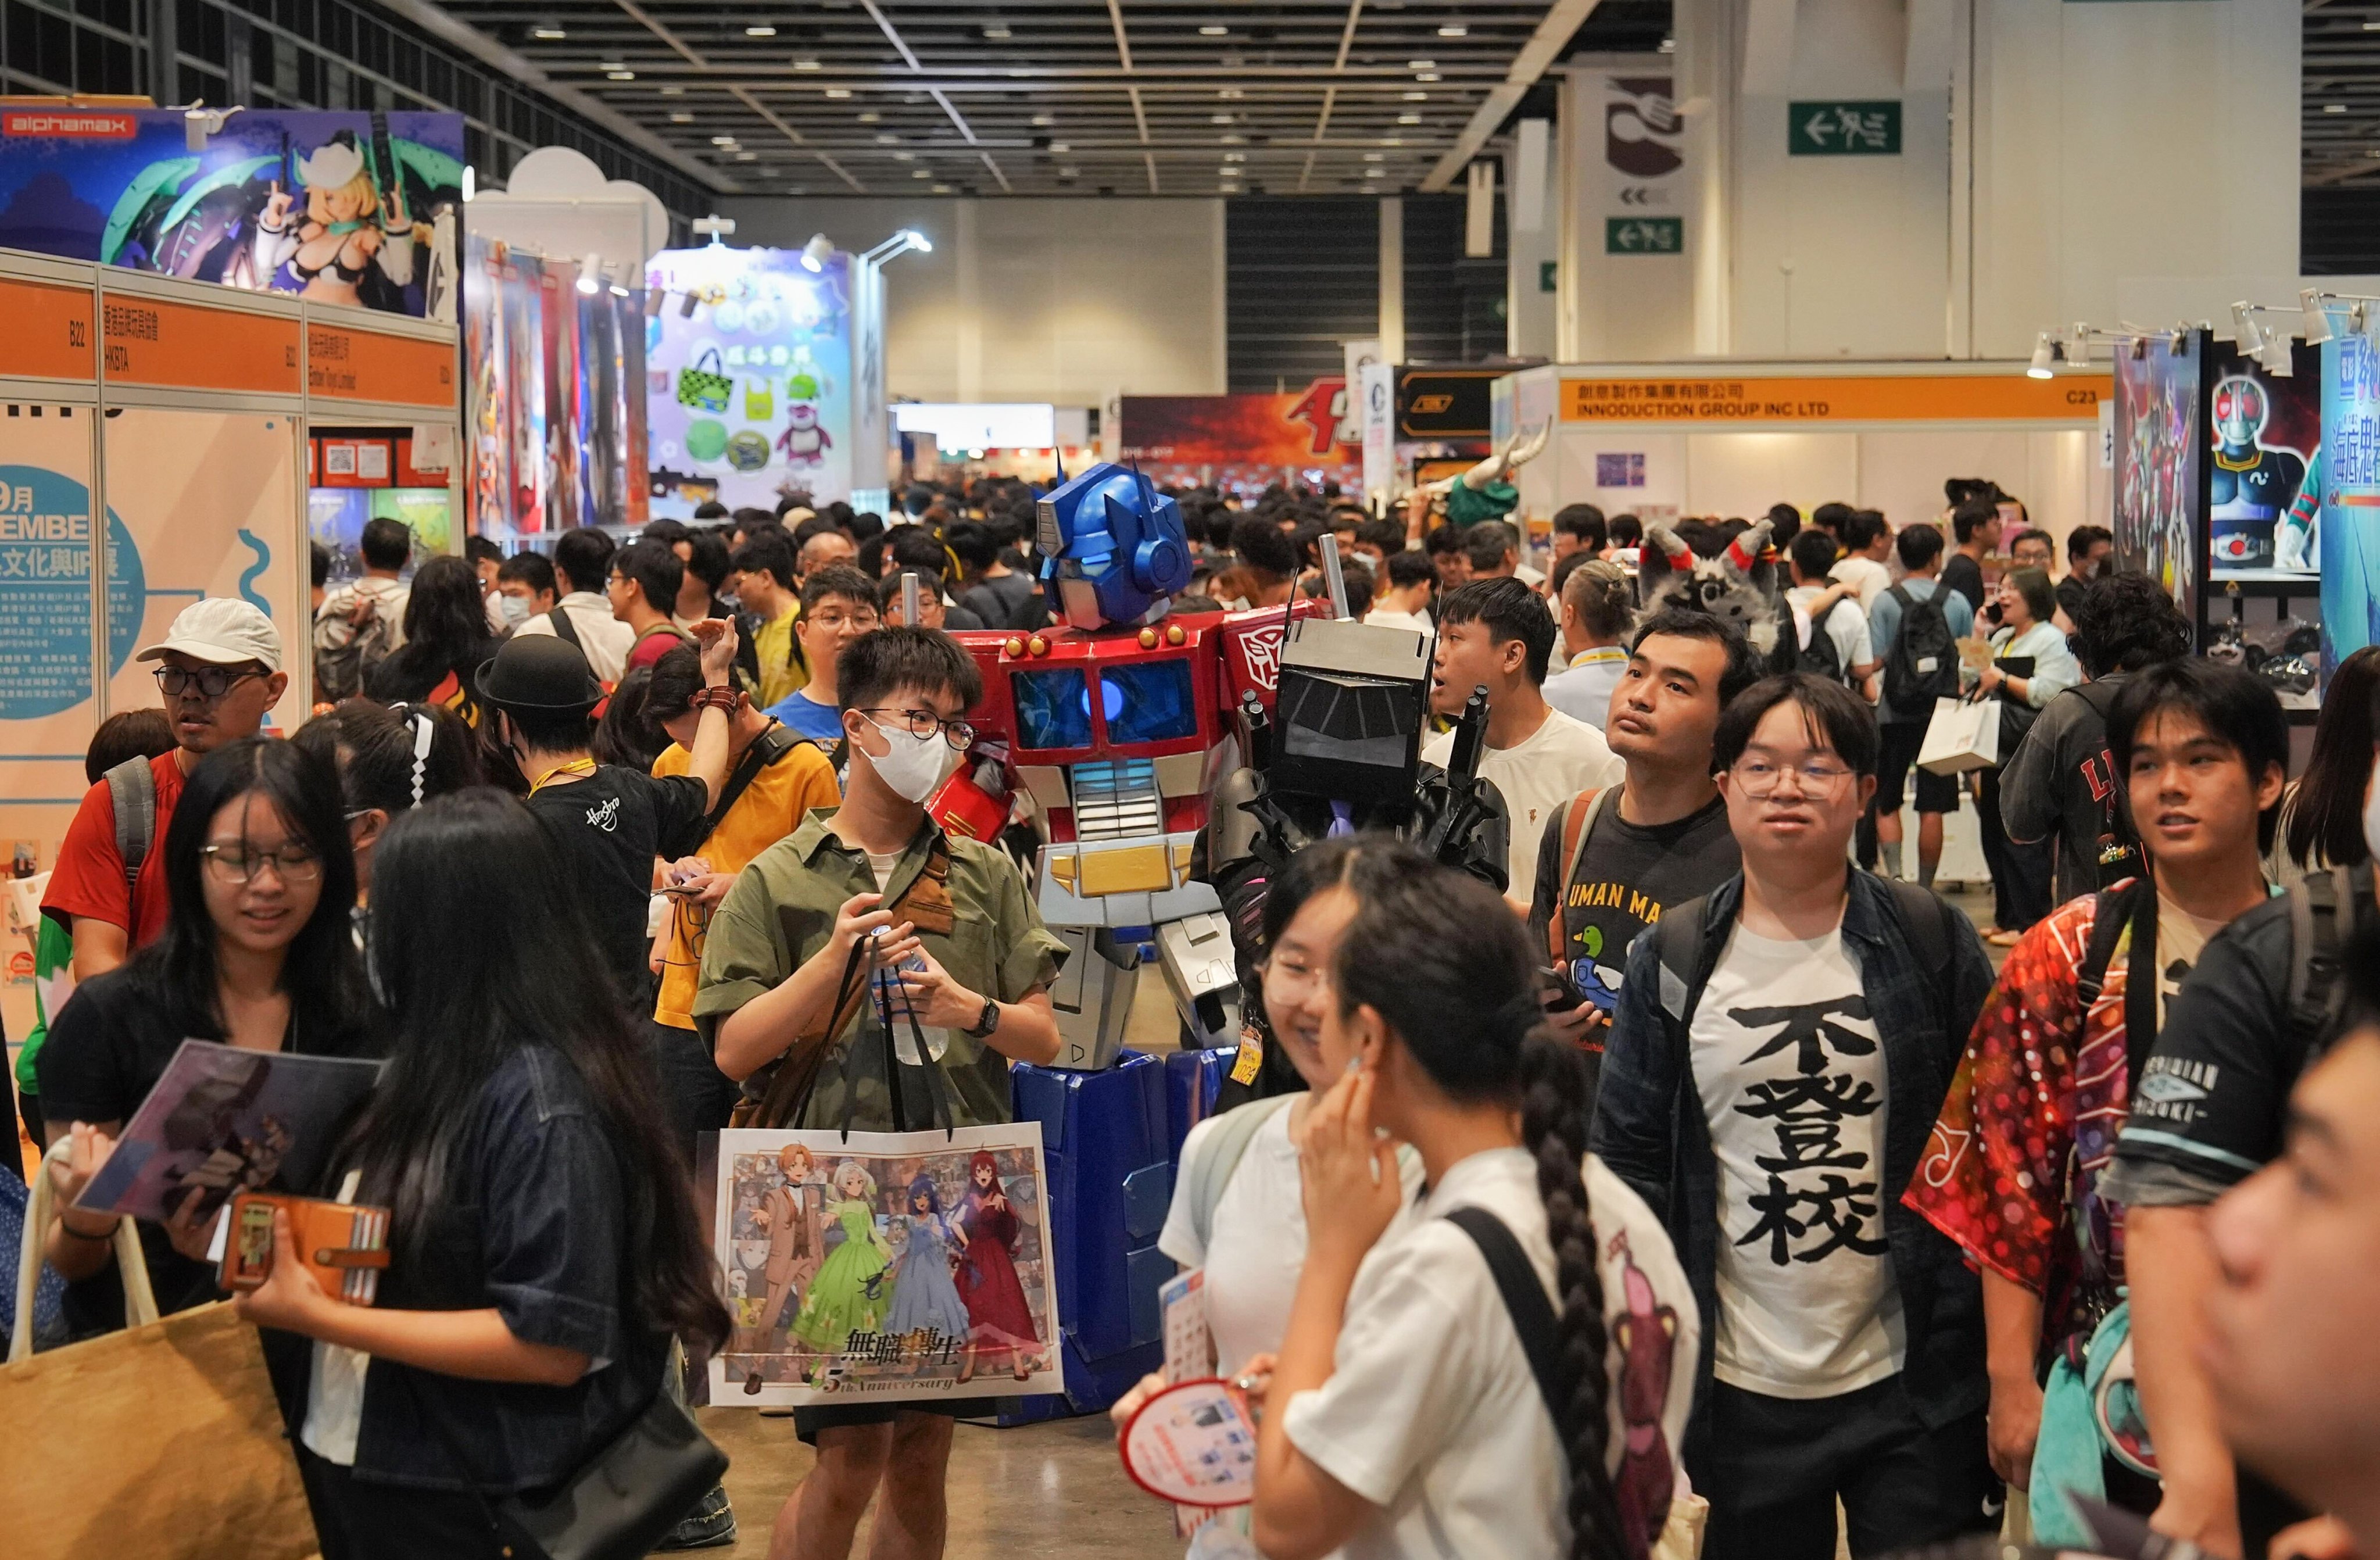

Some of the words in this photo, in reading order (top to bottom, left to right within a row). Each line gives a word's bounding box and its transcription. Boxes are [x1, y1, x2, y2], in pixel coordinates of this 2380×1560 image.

[12, 116, 126, 133] alphamax
[70, 320, 85, 348] B22
[105, 345, 130, 373] HKBTA
[1577, 402, 1694, 417] INNODUCTION
[1699, 402, 1759, 417] GROUP
[1765, 401, 1794, 415] INC
[1798, 401, 1830, 416] LTD
[2066, 389, 2097, 405] C23
[585, 797, 620, 826] Hasbro
[1569, 882, 1624, 908] UMAN
[1726, 994, 1889, 1266] 不登校
[857, 1378, 954, 1391] Anniversary
